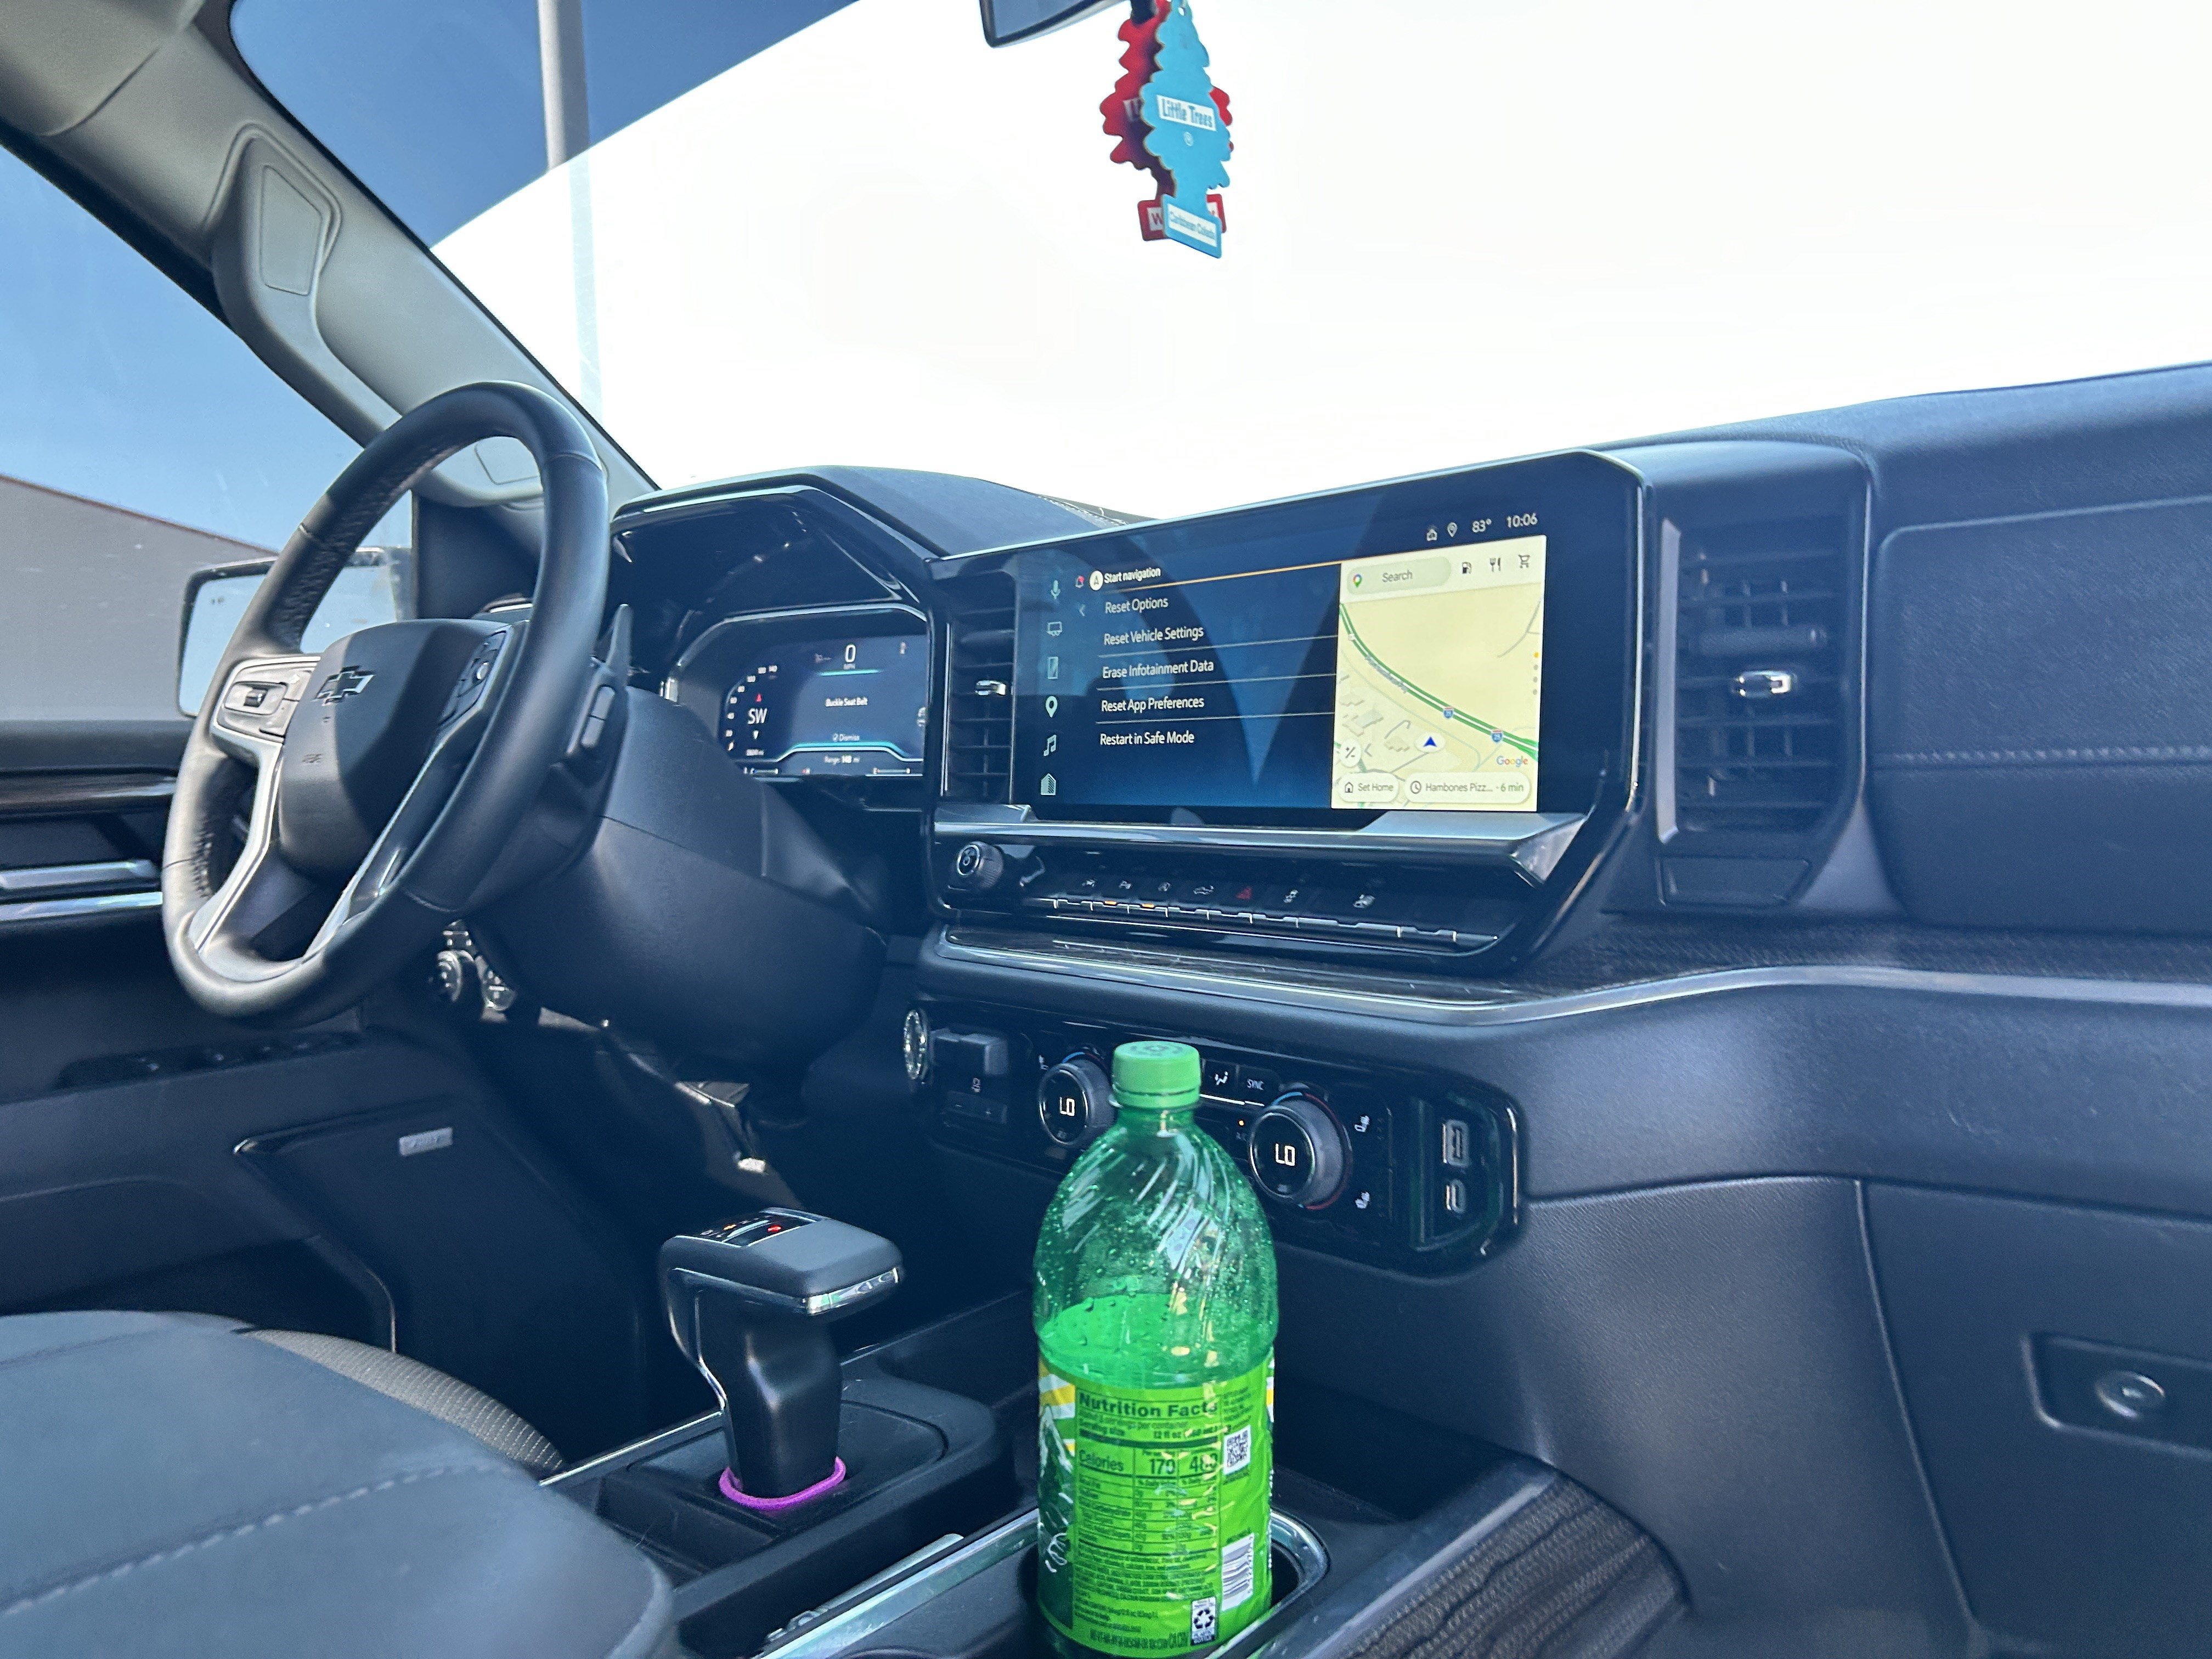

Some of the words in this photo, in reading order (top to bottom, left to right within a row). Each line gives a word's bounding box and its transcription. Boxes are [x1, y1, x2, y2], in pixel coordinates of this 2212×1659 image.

[1162, 98, 1187, 121] Little
[1188, 105, 1212, 128] Trees
[1472, 518, 1492, 533] 83°
[1506, 512, 1538, 528] 10:06
[1104, 573, 1122, 583] Start
[1123, 567, 1161, 582] navigation
[1382, 570, 1413, 583] Search
[1105, 601, 1131, 614] Reset
[1132, 597, 1169, 613] Options
[1104, 633, 1130, 646] Reset
[1130, 628, 1163, 643] Vehicle
[1164, 626, 1204, 641] Settings
[845, 644, 856, 663] 0
[1102, 666, 1127, 679] Erase
[1128, 662, 1188, 676] Infotainment
[1190, 659, 1214, 673] Data
[825, 697, 844, 707] Buckle
[844, 697, 856, 707] Seat
[856, 696, 868, 706] Belt
[1101, 699, 1127, 712] Reset
[1127, 698, 1147, 713] App
[1148, 696, 1205, 710] Preferences
[747, 707, 768, 725] SW
[1099, 733, 1133, 746] Restart
[1134, 732, 1143, 744] in
[1143, 731, 1165, 744] Safe
[1166, 730, 1195, 743] Mode
[1496, 755, 1528, 768] Google
[1357, 783, 1371, 792] Set
[1372, 783, 1393, 792] Home
[1425, 782, 1468, 792] Hambones
[1500, 783, 1506, 792] 6
[1508, 781, 1524, 792] min
[1059, 1096, 1075, 1116] LO
[1275, 1143, 1295, 1166] LO
[1079, 1392, 1161, 1417] Nutrition
[1079, 1449, 1124, 1472] Calories
[1149, 1459, 1176, 1475] 170
